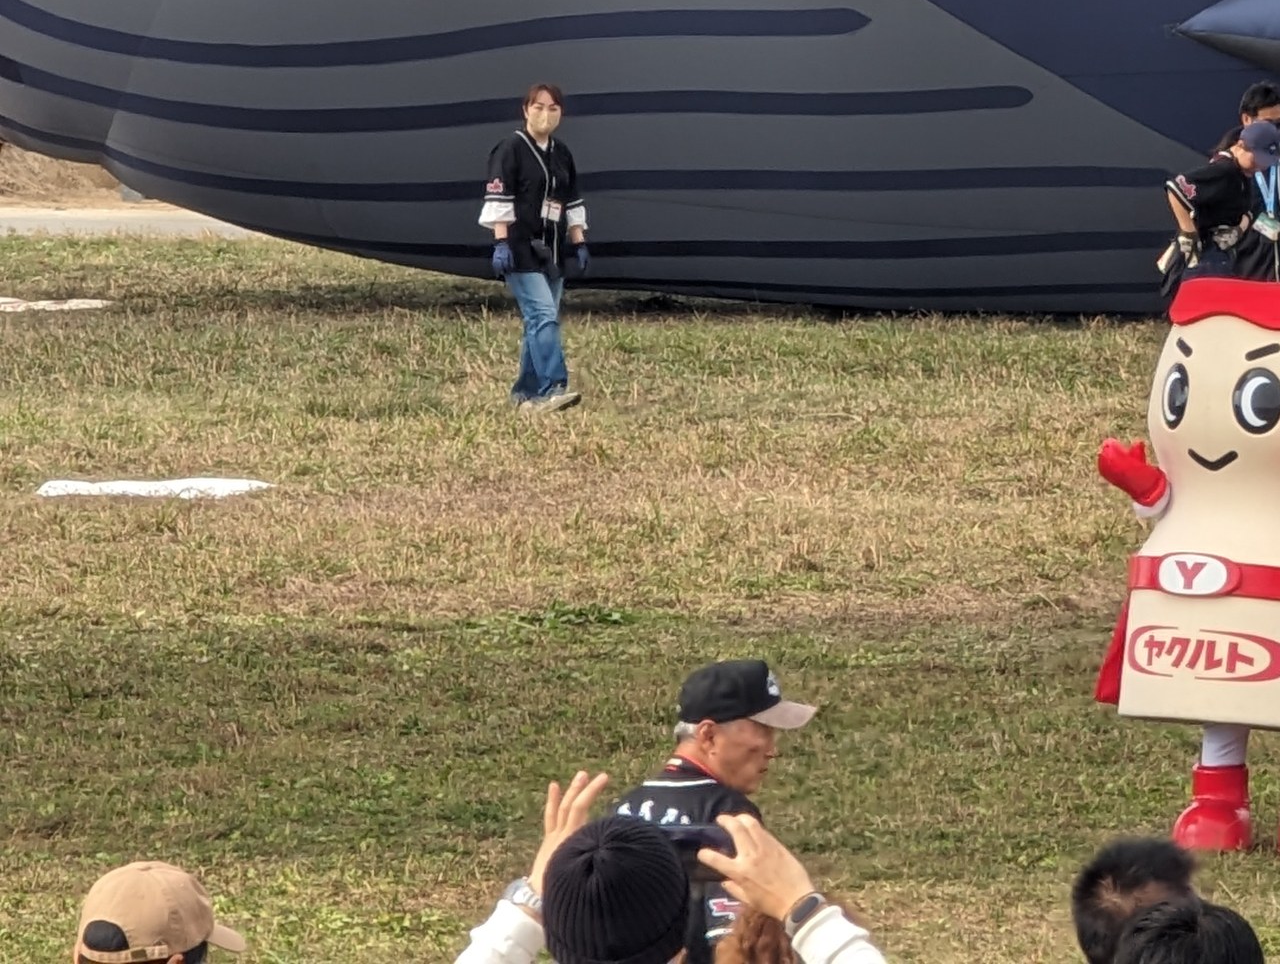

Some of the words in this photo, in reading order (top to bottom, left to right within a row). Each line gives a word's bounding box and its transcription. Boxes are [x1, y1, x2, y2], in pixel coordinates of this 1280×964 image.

[1175, 561, 1207, 589] Y
[1143, 635, 1255, 673] ヤクルト
